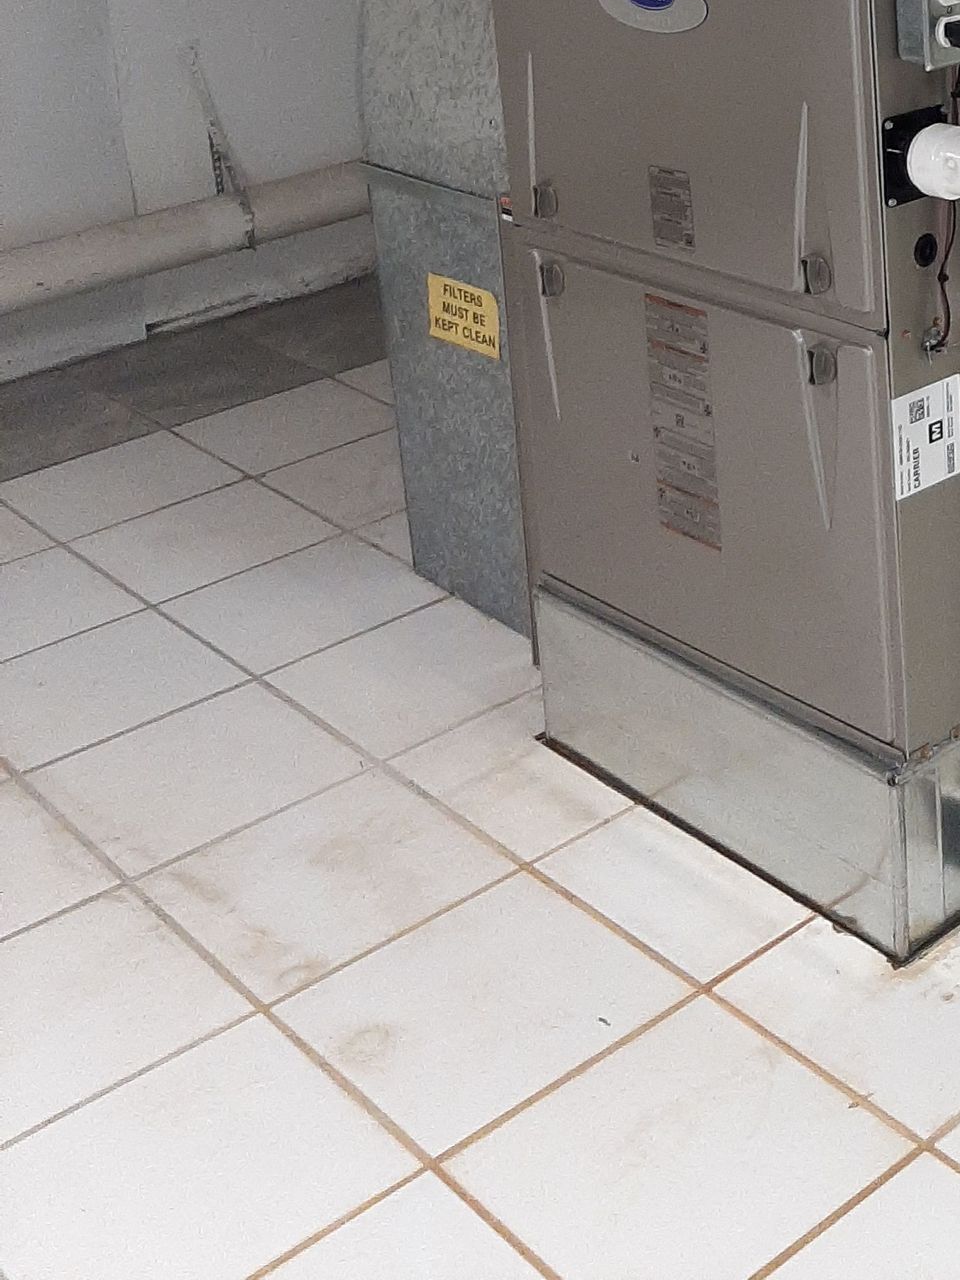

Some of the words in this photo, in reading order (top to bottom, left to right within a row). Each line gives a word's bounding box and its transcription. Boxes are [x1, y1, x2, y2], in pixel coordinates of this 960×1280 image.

[443, 284, 483, 307] FILTERS
[442, 301, 469, 320] MUST
[472, 312, 486, 327] BE
[434, 316, 459, 335] KEPT
[462, 326, 496, 350] CLEAN
